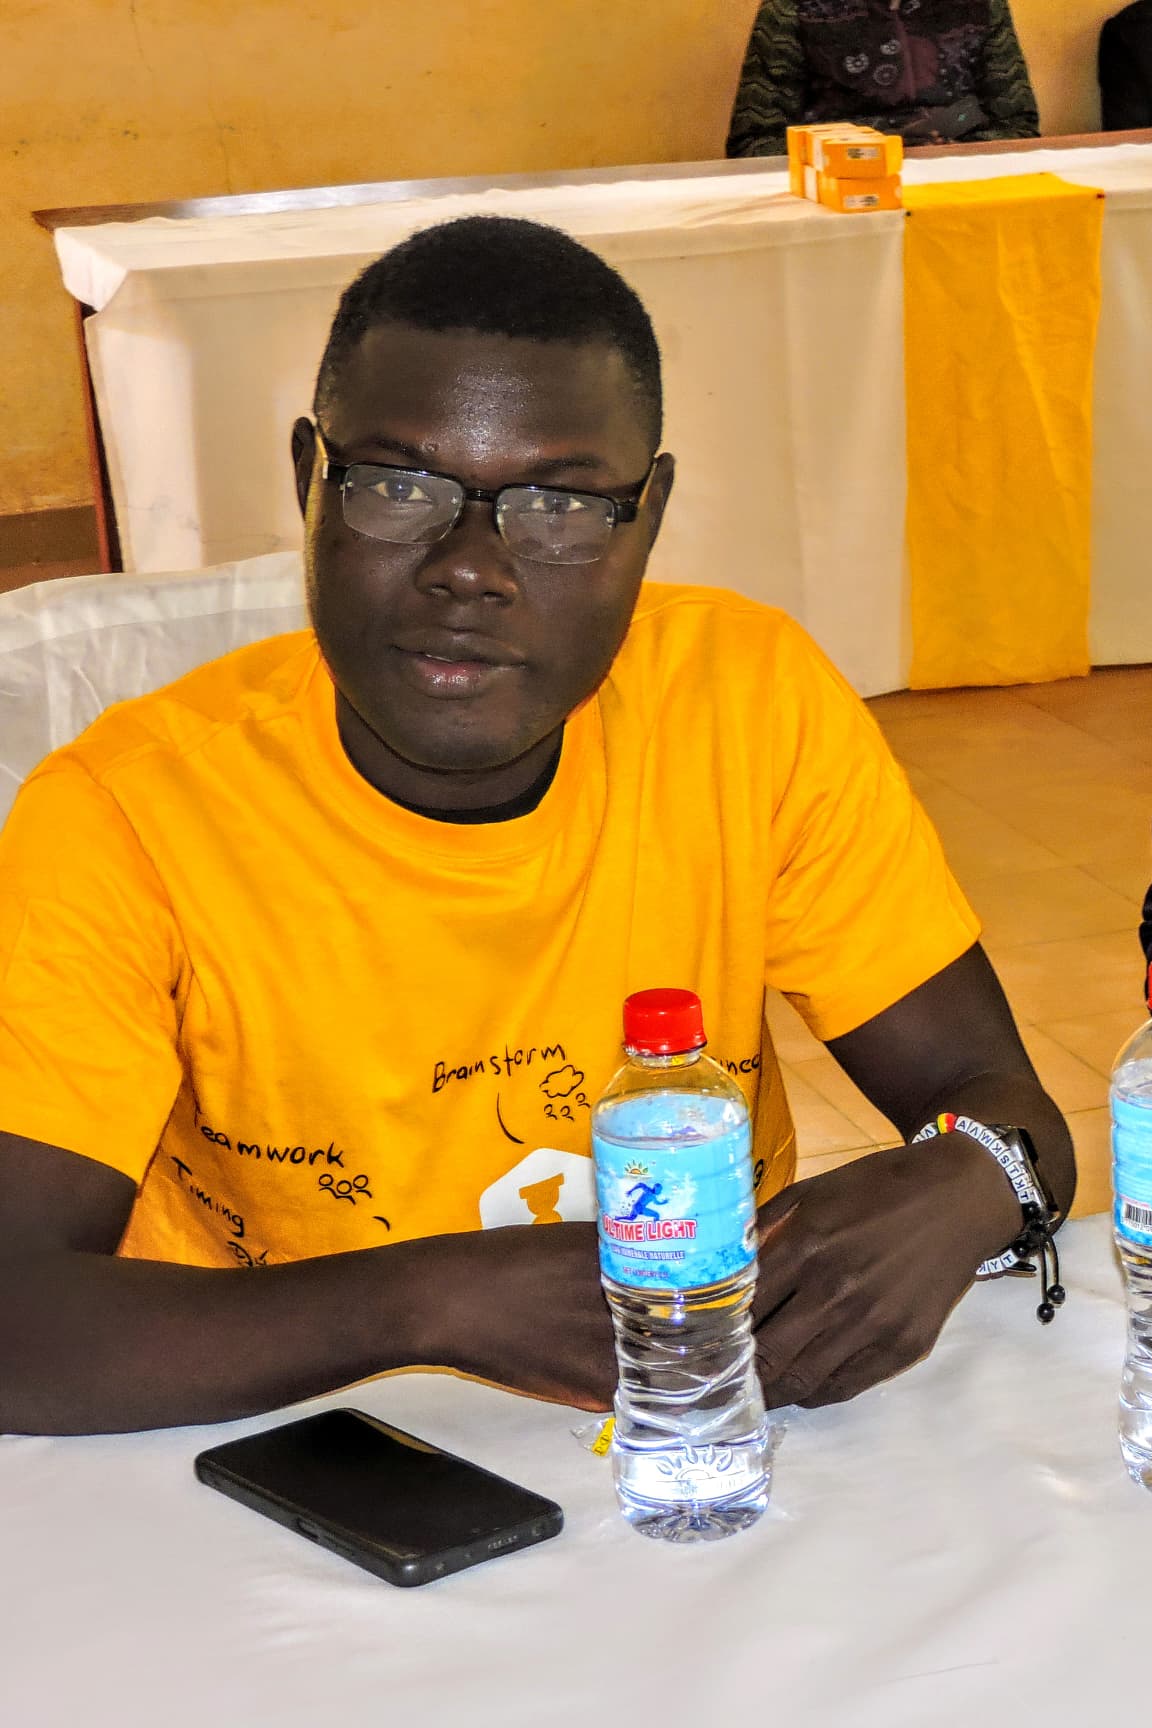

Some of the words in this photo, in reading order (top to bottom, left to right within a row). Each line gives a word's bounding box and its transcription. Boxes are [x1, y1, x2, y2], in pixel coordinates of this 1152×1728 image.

[431, 1043, 566, 1094] Brainstorm
[171, 1156, 245, 1238] Timing
[602, 1214, 645, 1242] ULTIME
[647, 1220, 697, 1241] LIGHT
